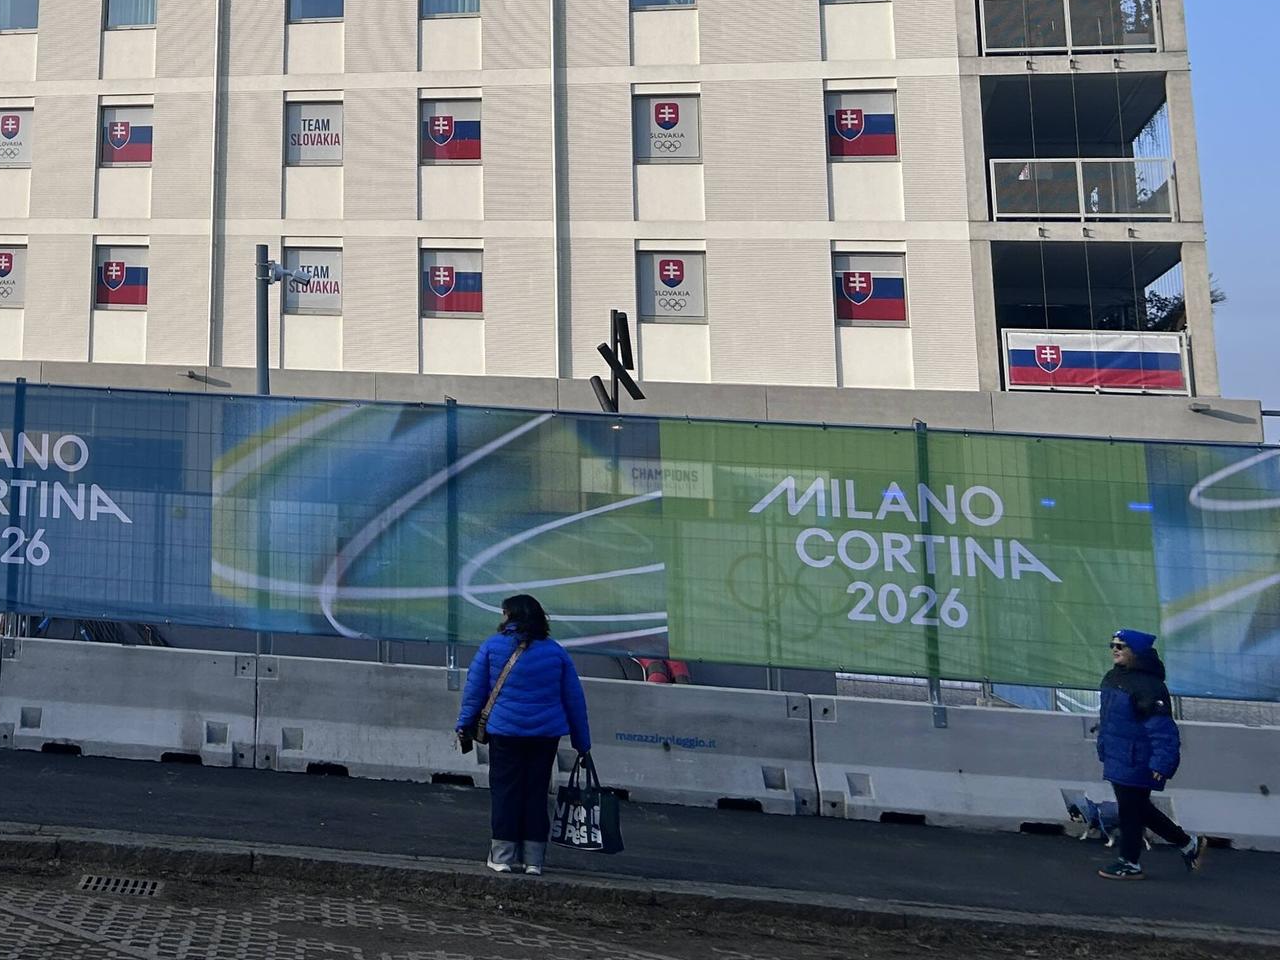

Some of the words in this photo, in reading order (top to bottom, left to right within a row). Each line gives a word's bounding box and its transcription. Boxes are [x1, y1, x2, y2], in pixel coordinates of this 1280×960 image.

[290, 132, 340, 146] SLOVAKIA
[301, 119, 330, 131] TEAM
[631, 466, 698, 482] CHAMPIONS
[748, 475, 1003, 527] MILANO
[795, 527, 1063, 583] CORTINA
[846, 581, 968, 628] 2026
